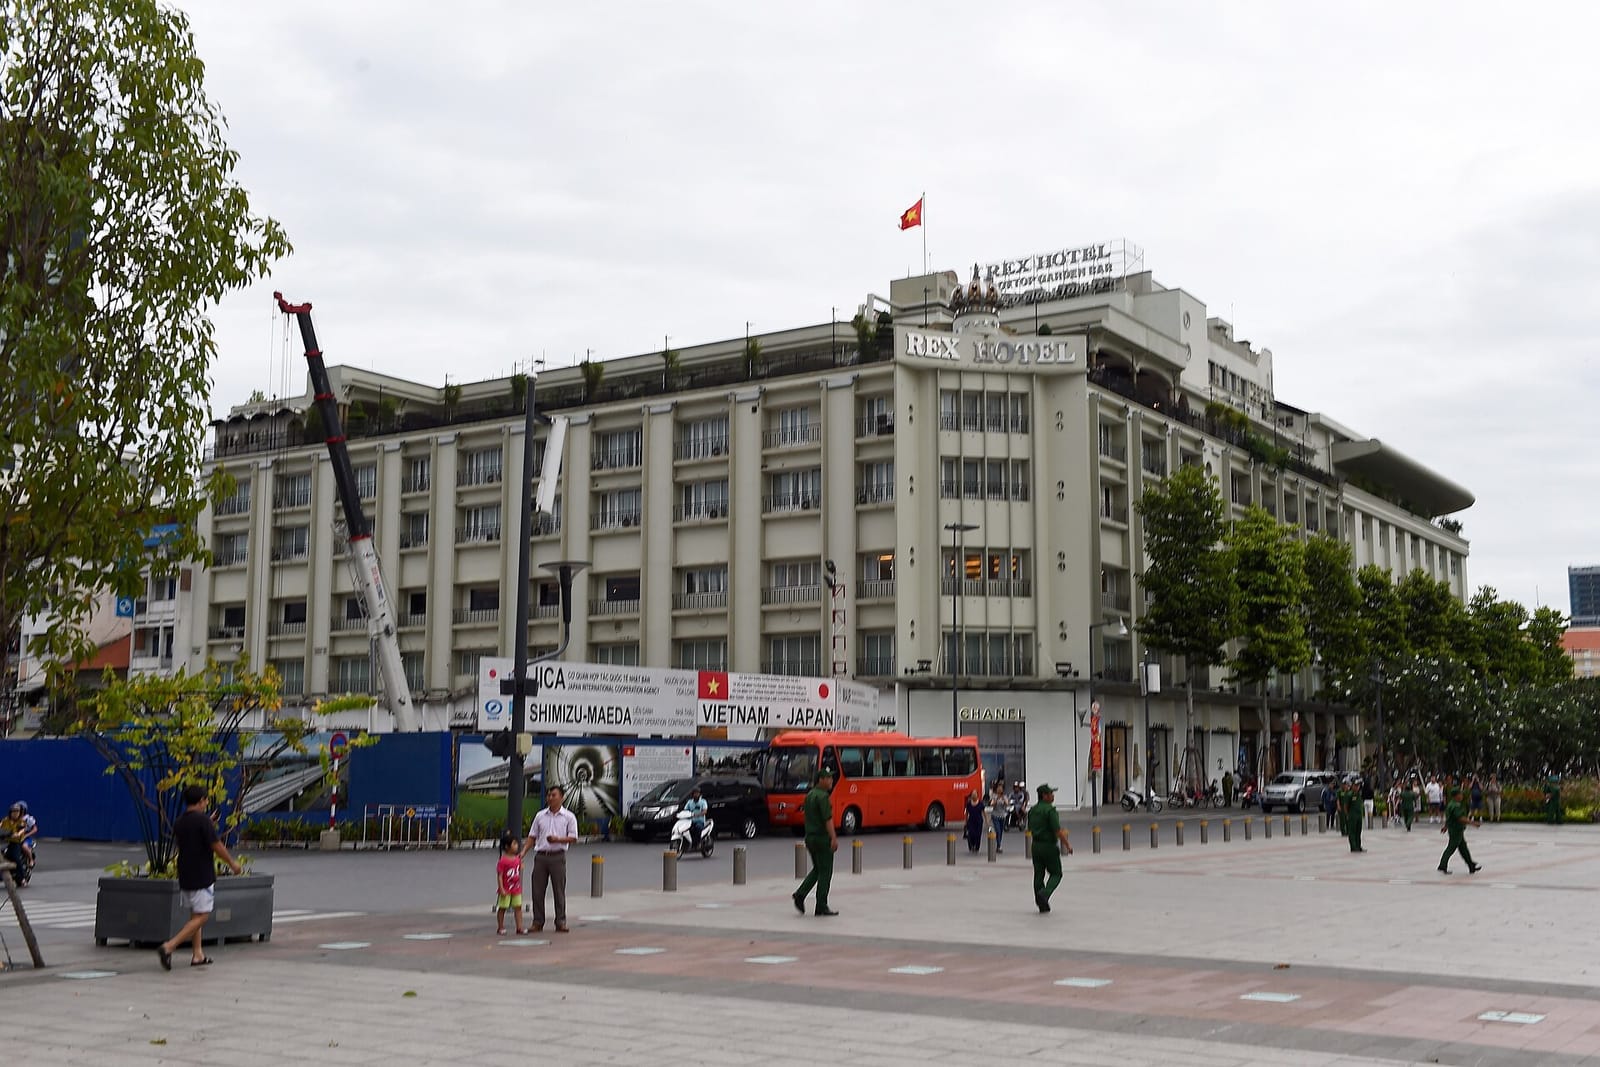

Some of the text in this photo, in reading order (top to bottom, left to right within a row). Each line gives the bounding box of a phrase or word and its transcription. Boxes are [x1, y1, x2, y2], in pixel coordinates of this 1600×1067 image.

[986, 245, 1111, 278] REX HOTEL
[1037, 267, 1086, 283] GARDEN
[1088, 263, 1112, 275] BAR
[906, 332, 1076, 364] REX HOTEL
[529, 702, 632, 726] SHIMIZU-MAEDA
[702, 703, 769, 726] VIETNAM
[787, 706, 834, 727] JAPAN
[959, 706, 1026, 721] CHANEL
